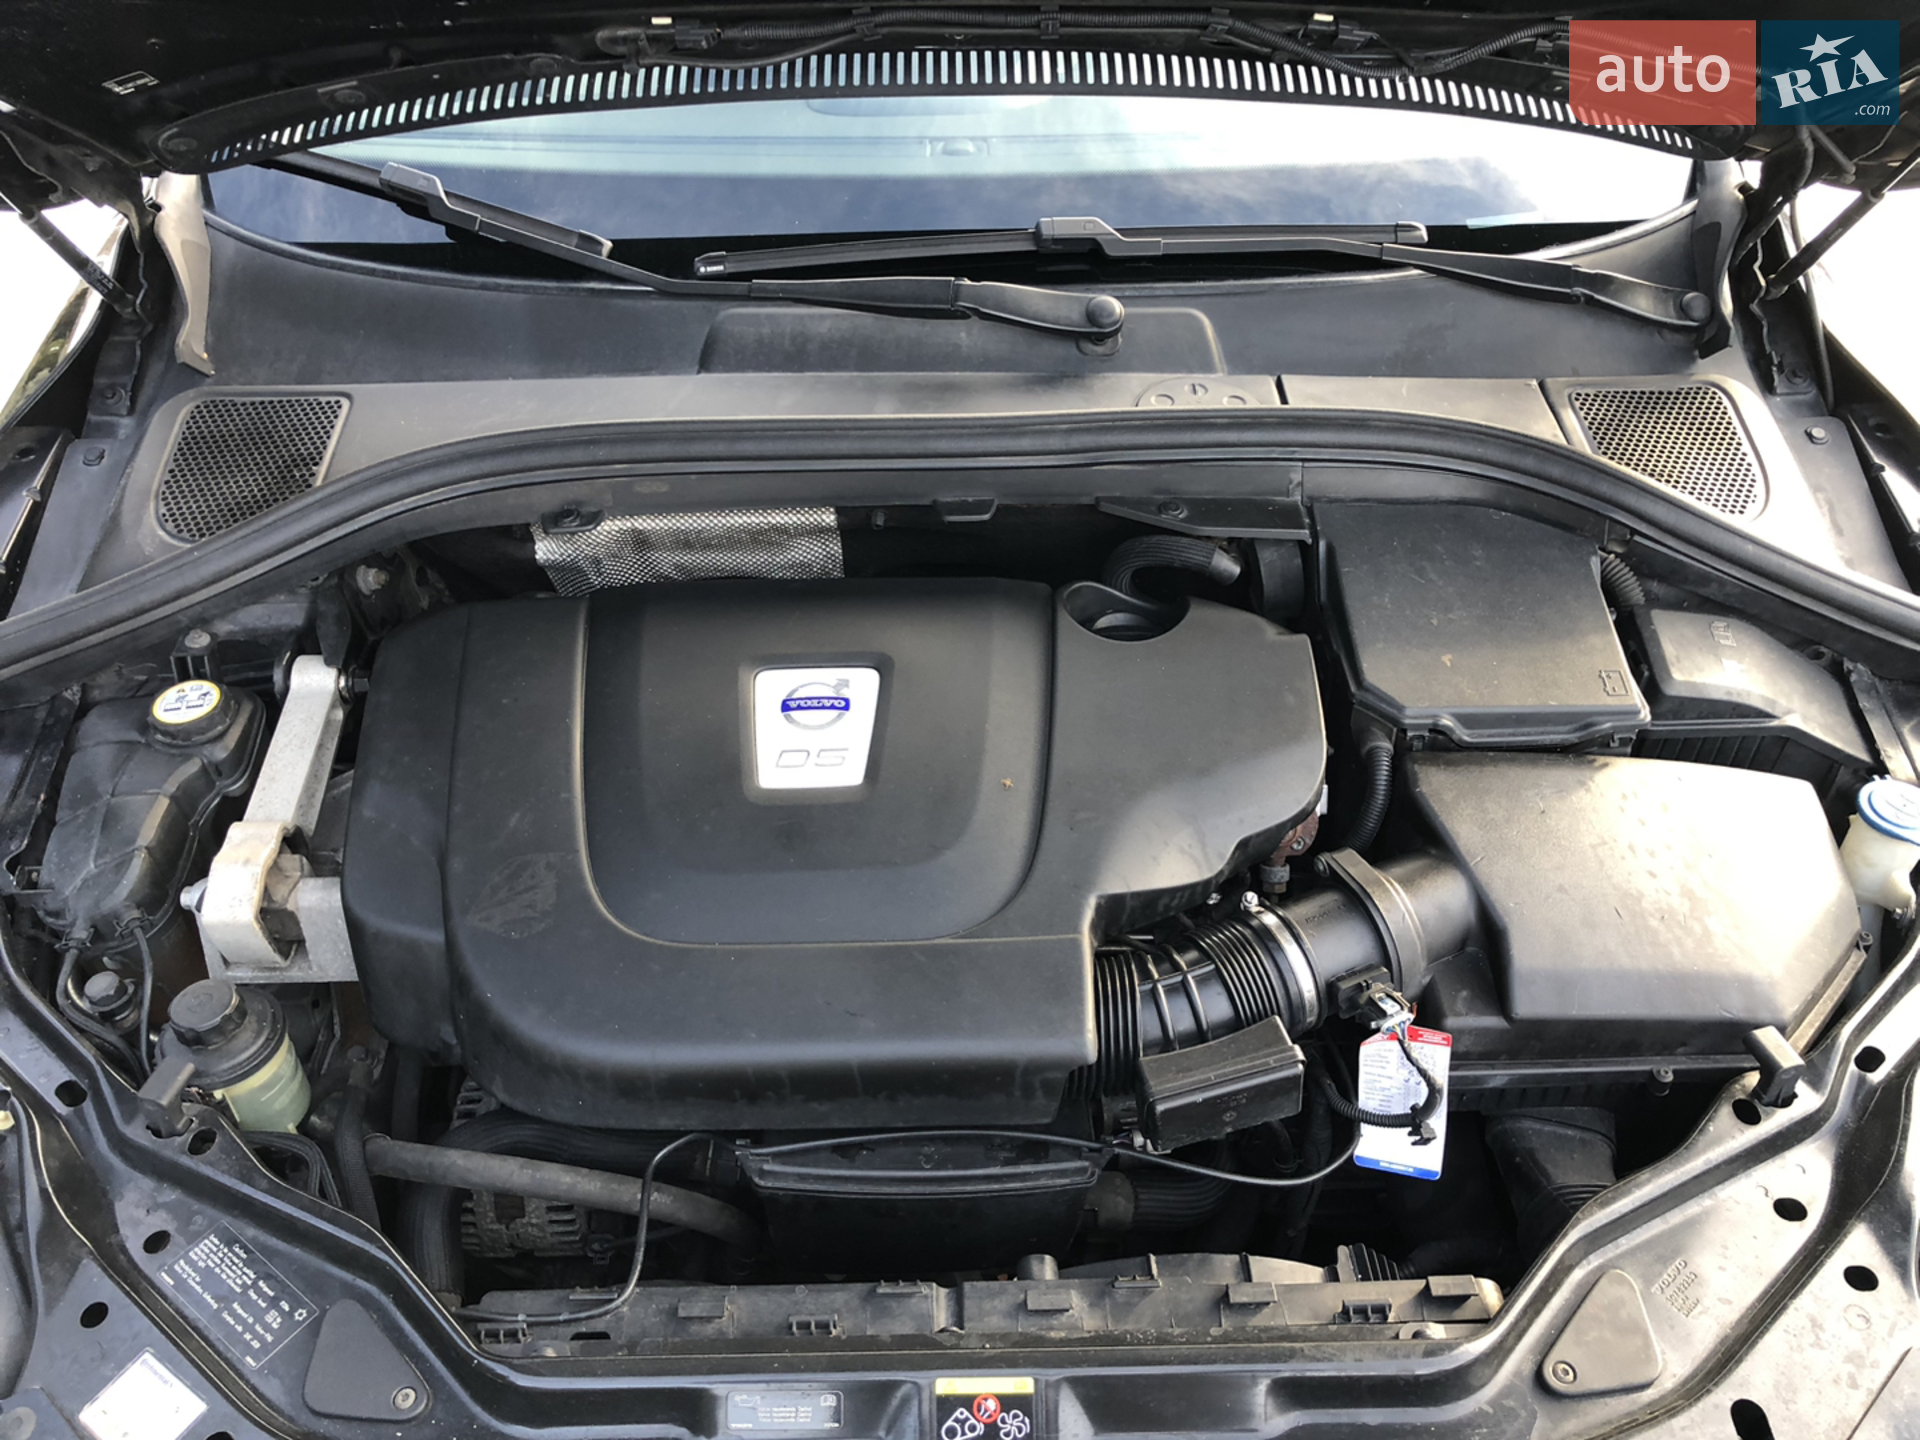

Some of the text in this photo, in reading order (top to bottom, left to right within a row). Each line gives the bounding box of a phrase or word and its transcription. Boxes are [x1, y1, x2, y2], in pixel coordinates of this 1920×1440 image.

[786, 699, 846, 708] VOLVO
[776, 748, 849, 768] D5
[1651, 1259, 1687, 1294] VOLVO
